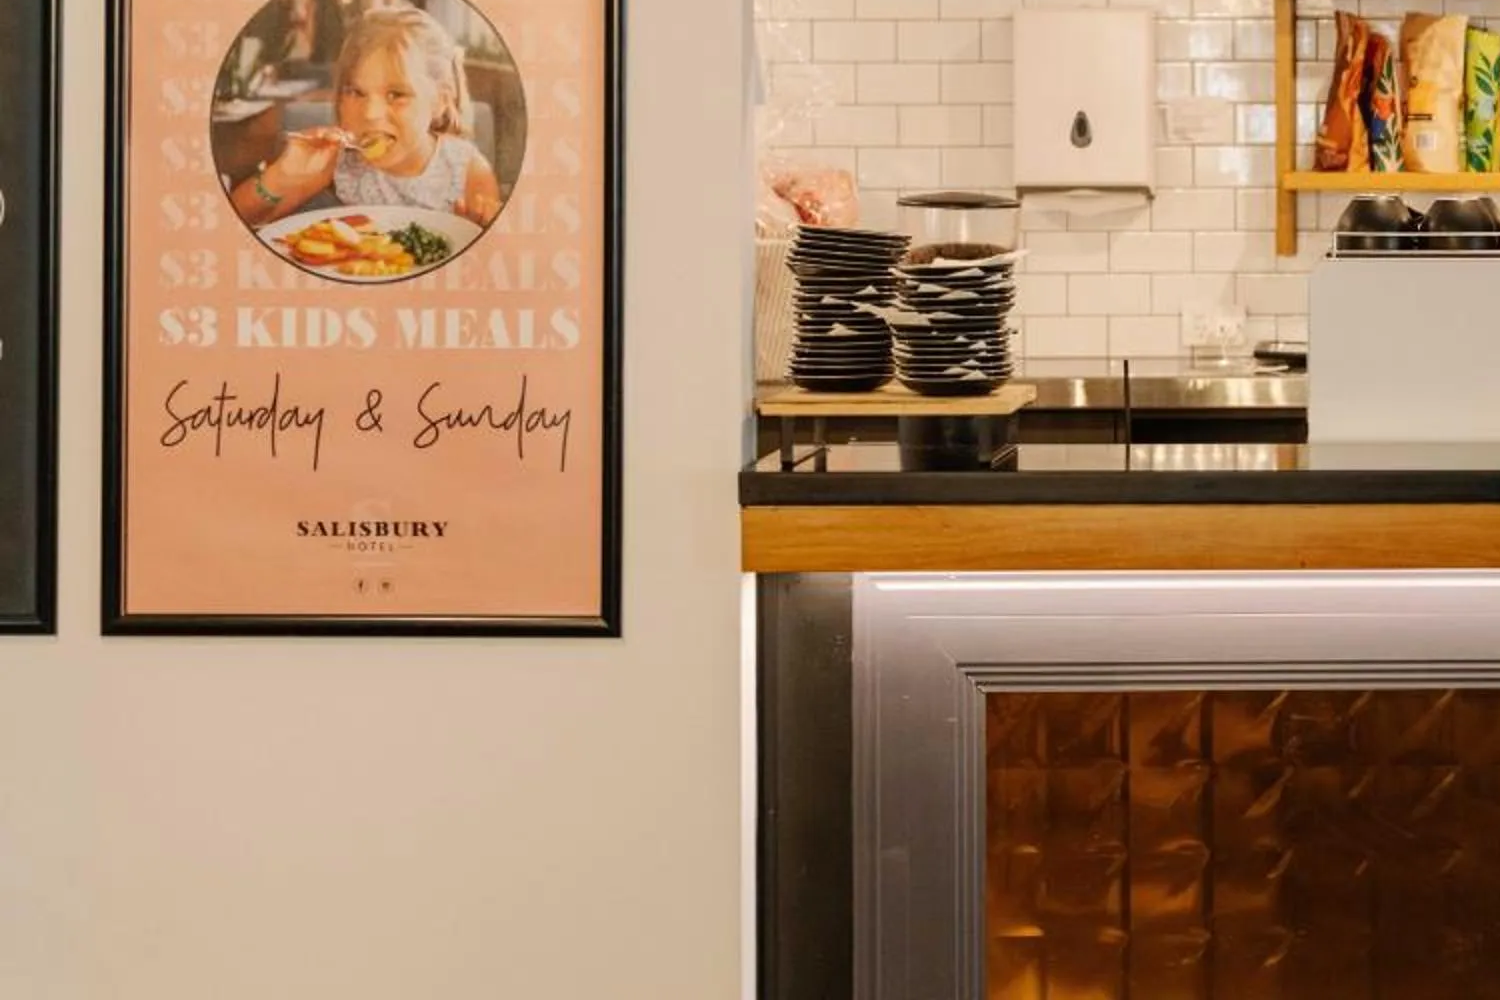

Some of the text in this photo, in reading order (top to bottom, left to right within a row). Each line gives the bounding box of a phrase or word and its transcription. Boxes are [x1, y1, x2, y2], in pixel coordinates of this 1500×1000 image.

[236, 306, 378, 348] KIDS
[396, 307, 581, 350] MEALS
[159, 371, 572, 473] Saturday & Sunday
[296, 520, 449, 538] SALISBURY
[346, 541, 395, 553] HOTEL
